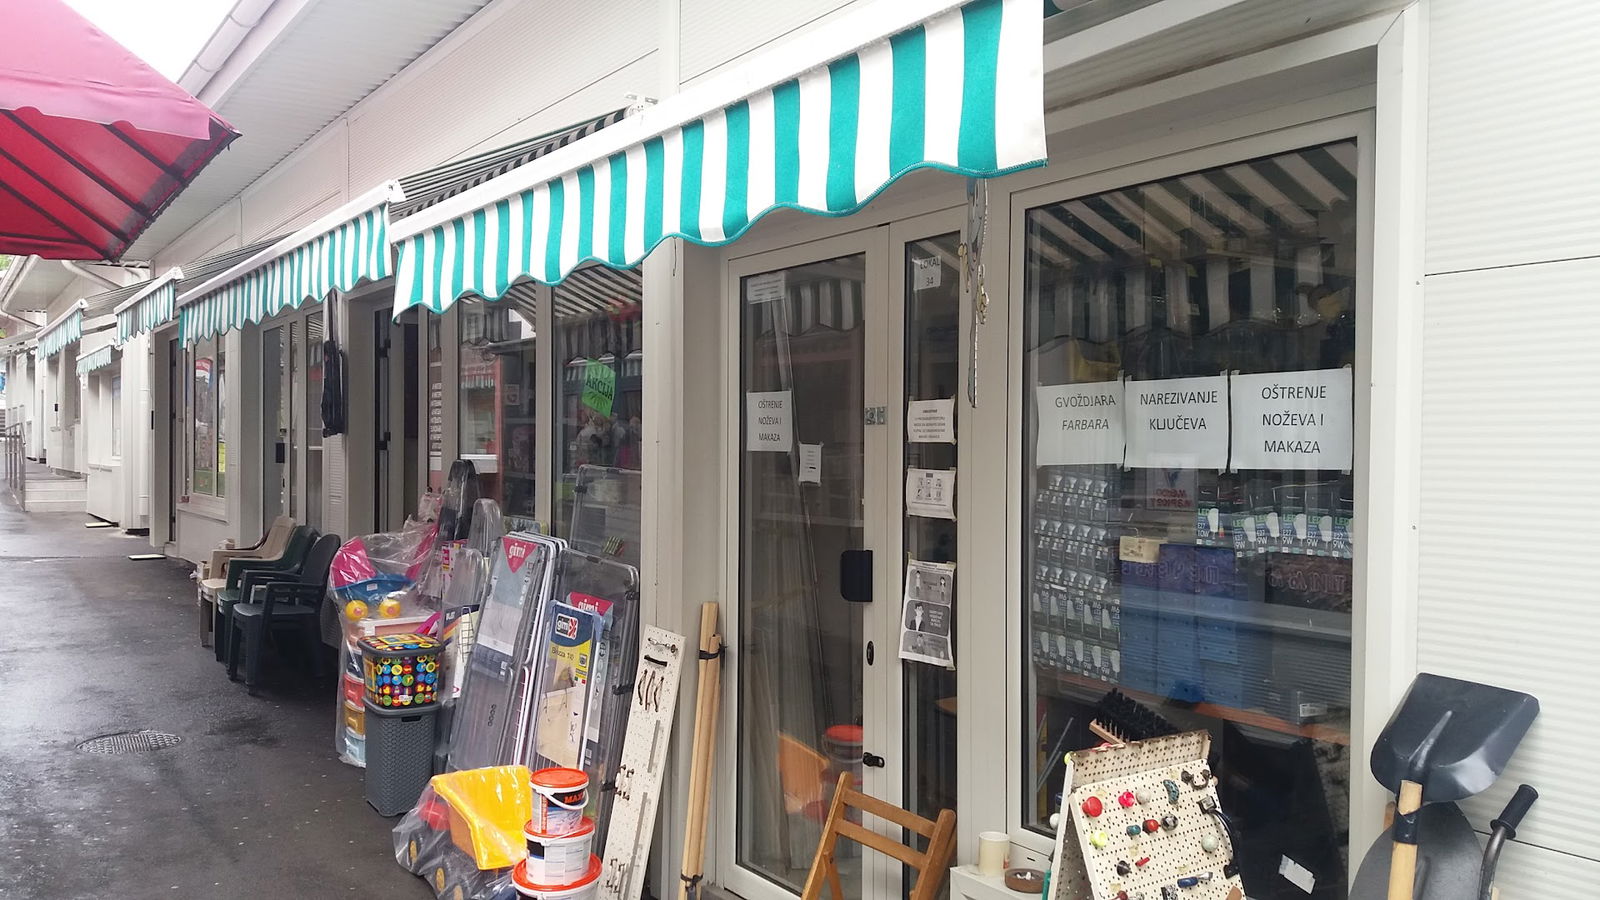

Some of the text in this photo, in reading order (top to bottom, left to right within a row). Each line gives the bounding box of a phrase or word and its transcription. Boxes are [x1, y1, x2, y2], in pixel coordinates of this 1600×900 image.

[919, 257, 941, 270] LOKAL
[585, 374, 613, 401] AKCIJA
[1261, 383, 1327, 400] OŠTRENJE
[757, 398, 783, 409] OŠTRENJE
[1055, 393, 1117, 408] GVOŽDJARA
[1140, 390, 1218, 406] NAREZIVANJE
[758, 415, 779, 425] NOŽEVA
[1062, 418, 1109, 431] FARBARA
[1149, 414, 1207, 431] KLJUČEVA
[1262, 410, 1324, 426] NOŽEVA I
[758, 433, 781, 441] MAKAZA
[1264, 440, 1321, 454] MAKAZA
[1256, 537, 1268, 545] 9W
[1282, 536, 1293, 545] 9W
[1306, 538, 1318, 547] 9W
[1332, 540, 1345, 549] 9W
[508, 542, 527, 559] gimi
